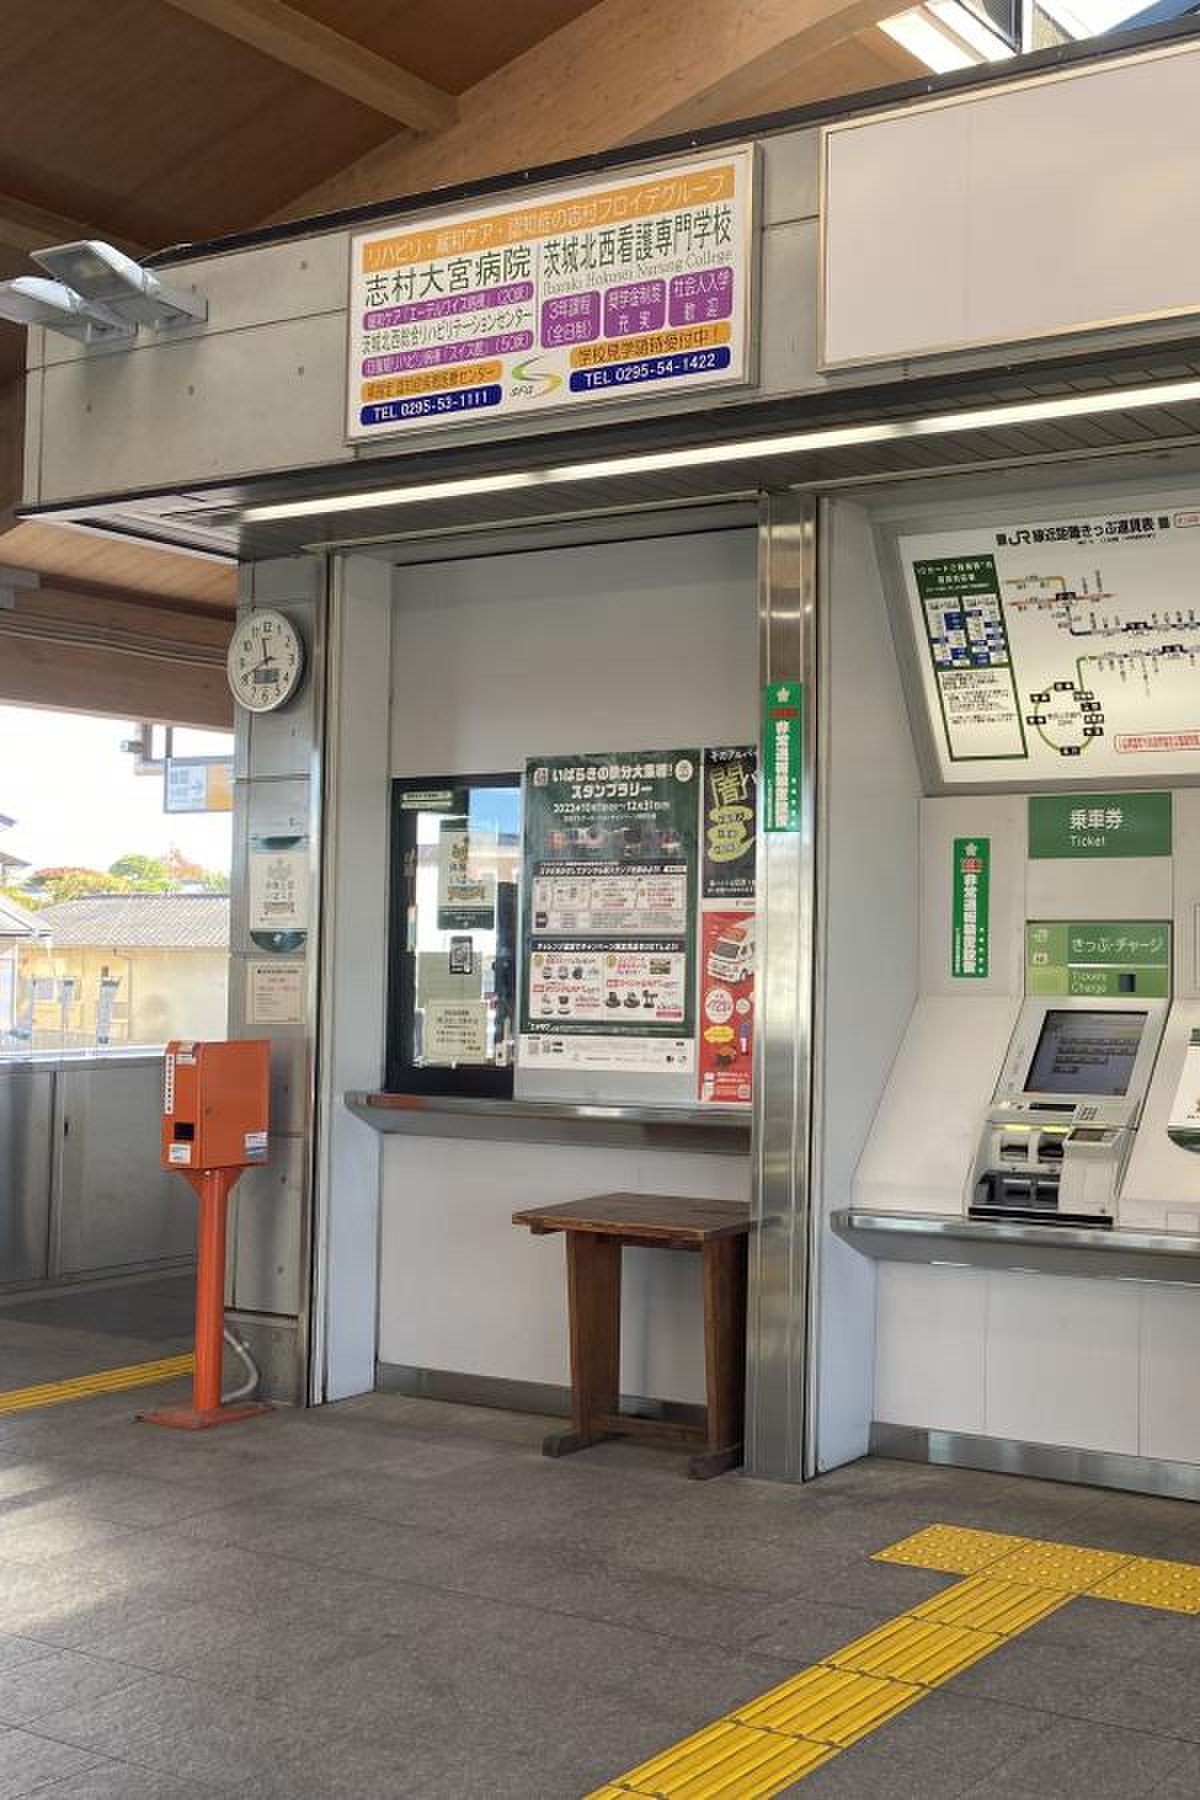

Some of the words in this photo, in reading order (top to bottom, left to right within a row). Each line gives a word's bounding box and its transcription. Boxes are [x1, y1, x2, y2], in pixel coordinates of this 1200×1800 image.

[544, 205, 732, 278] 茨城北西看護専門学校
[365, 245, 531, 307] 志村大宮病院
[584, 370, 610, 387] TEL
[615, 352, 717, 382] 0295-54-1422
[374, 405, 397, 421] TEL
[571, 783, 653, 800] スタンプラリー
[1070, 808, 1123, 830] 乗車券
[1070, 835, 1106, 847] Ticket
